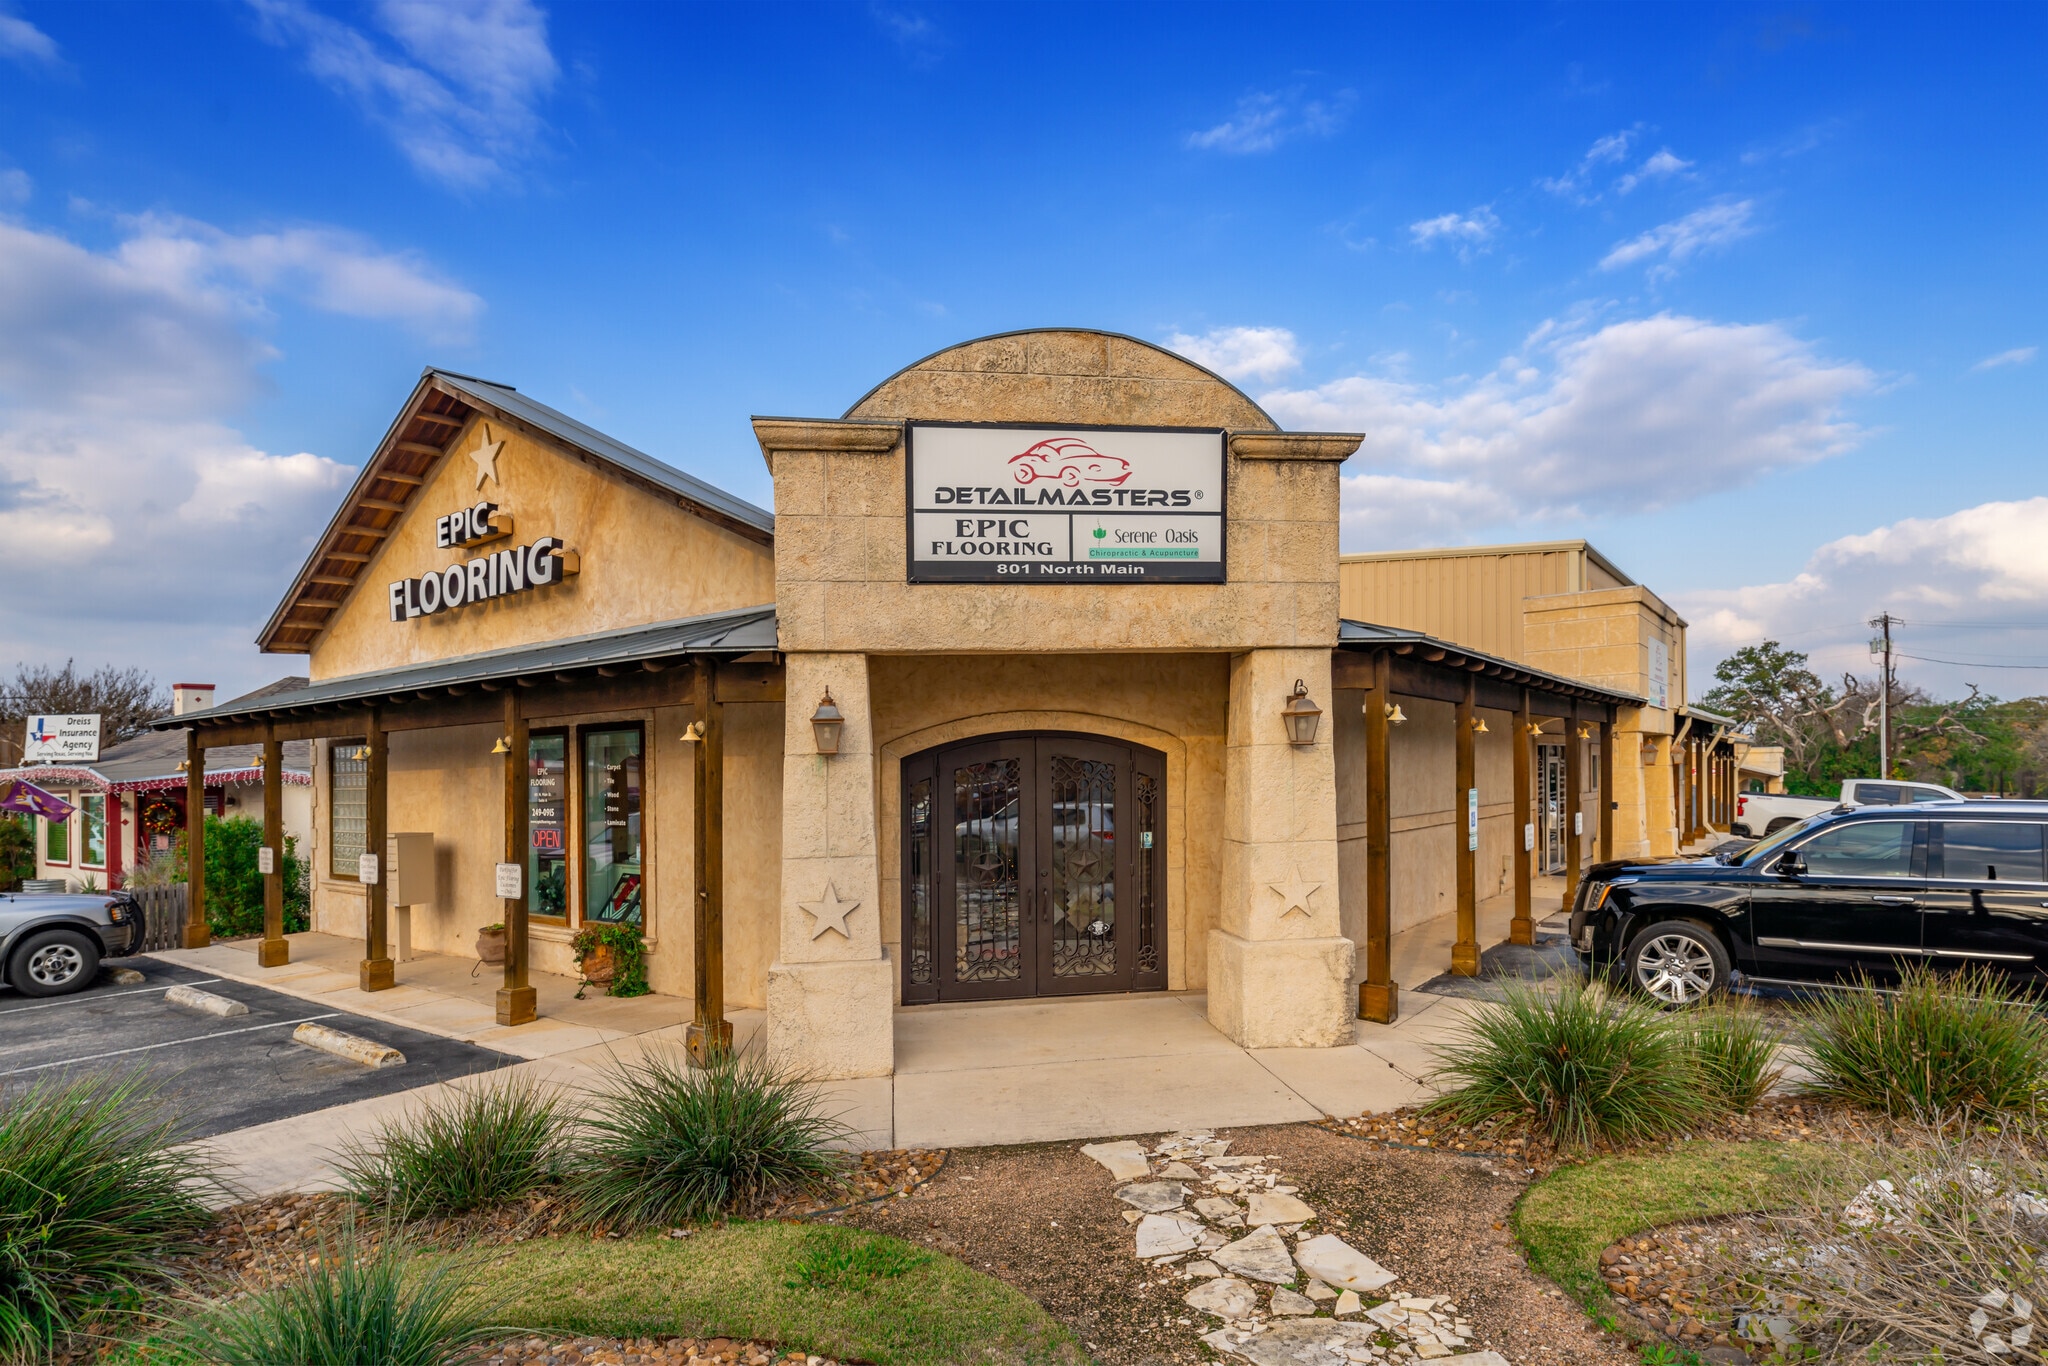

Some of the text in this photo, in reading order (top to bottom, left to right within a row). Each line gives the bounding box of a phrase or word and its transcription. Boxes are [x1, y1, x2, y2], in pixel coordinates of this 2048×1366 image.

[436, 502, 495, 548] EPIC
[955, 519, 1030, 538] EPIC
[1114, 528, 1199, 543] Serene Oasis
[931, 541, 1053, 555] FLOORING
[1089, 549, 1138, 558] Chiropractic
[1150, 550, 1199, 558] Acupuncture
[996, 564, 1145, 574] 801 North Main
[389, 537, 561, 621] FLOORING
[67, 717, 91, 725] Dreiss
[59, 729, 98, 737] Insurance
[62, 740, 93, 750] Agency
[537, 768, 548, 776] EPIC
[532, 808, 555, 817] 249-0915
[532, 830, 560, 849] OPEN
